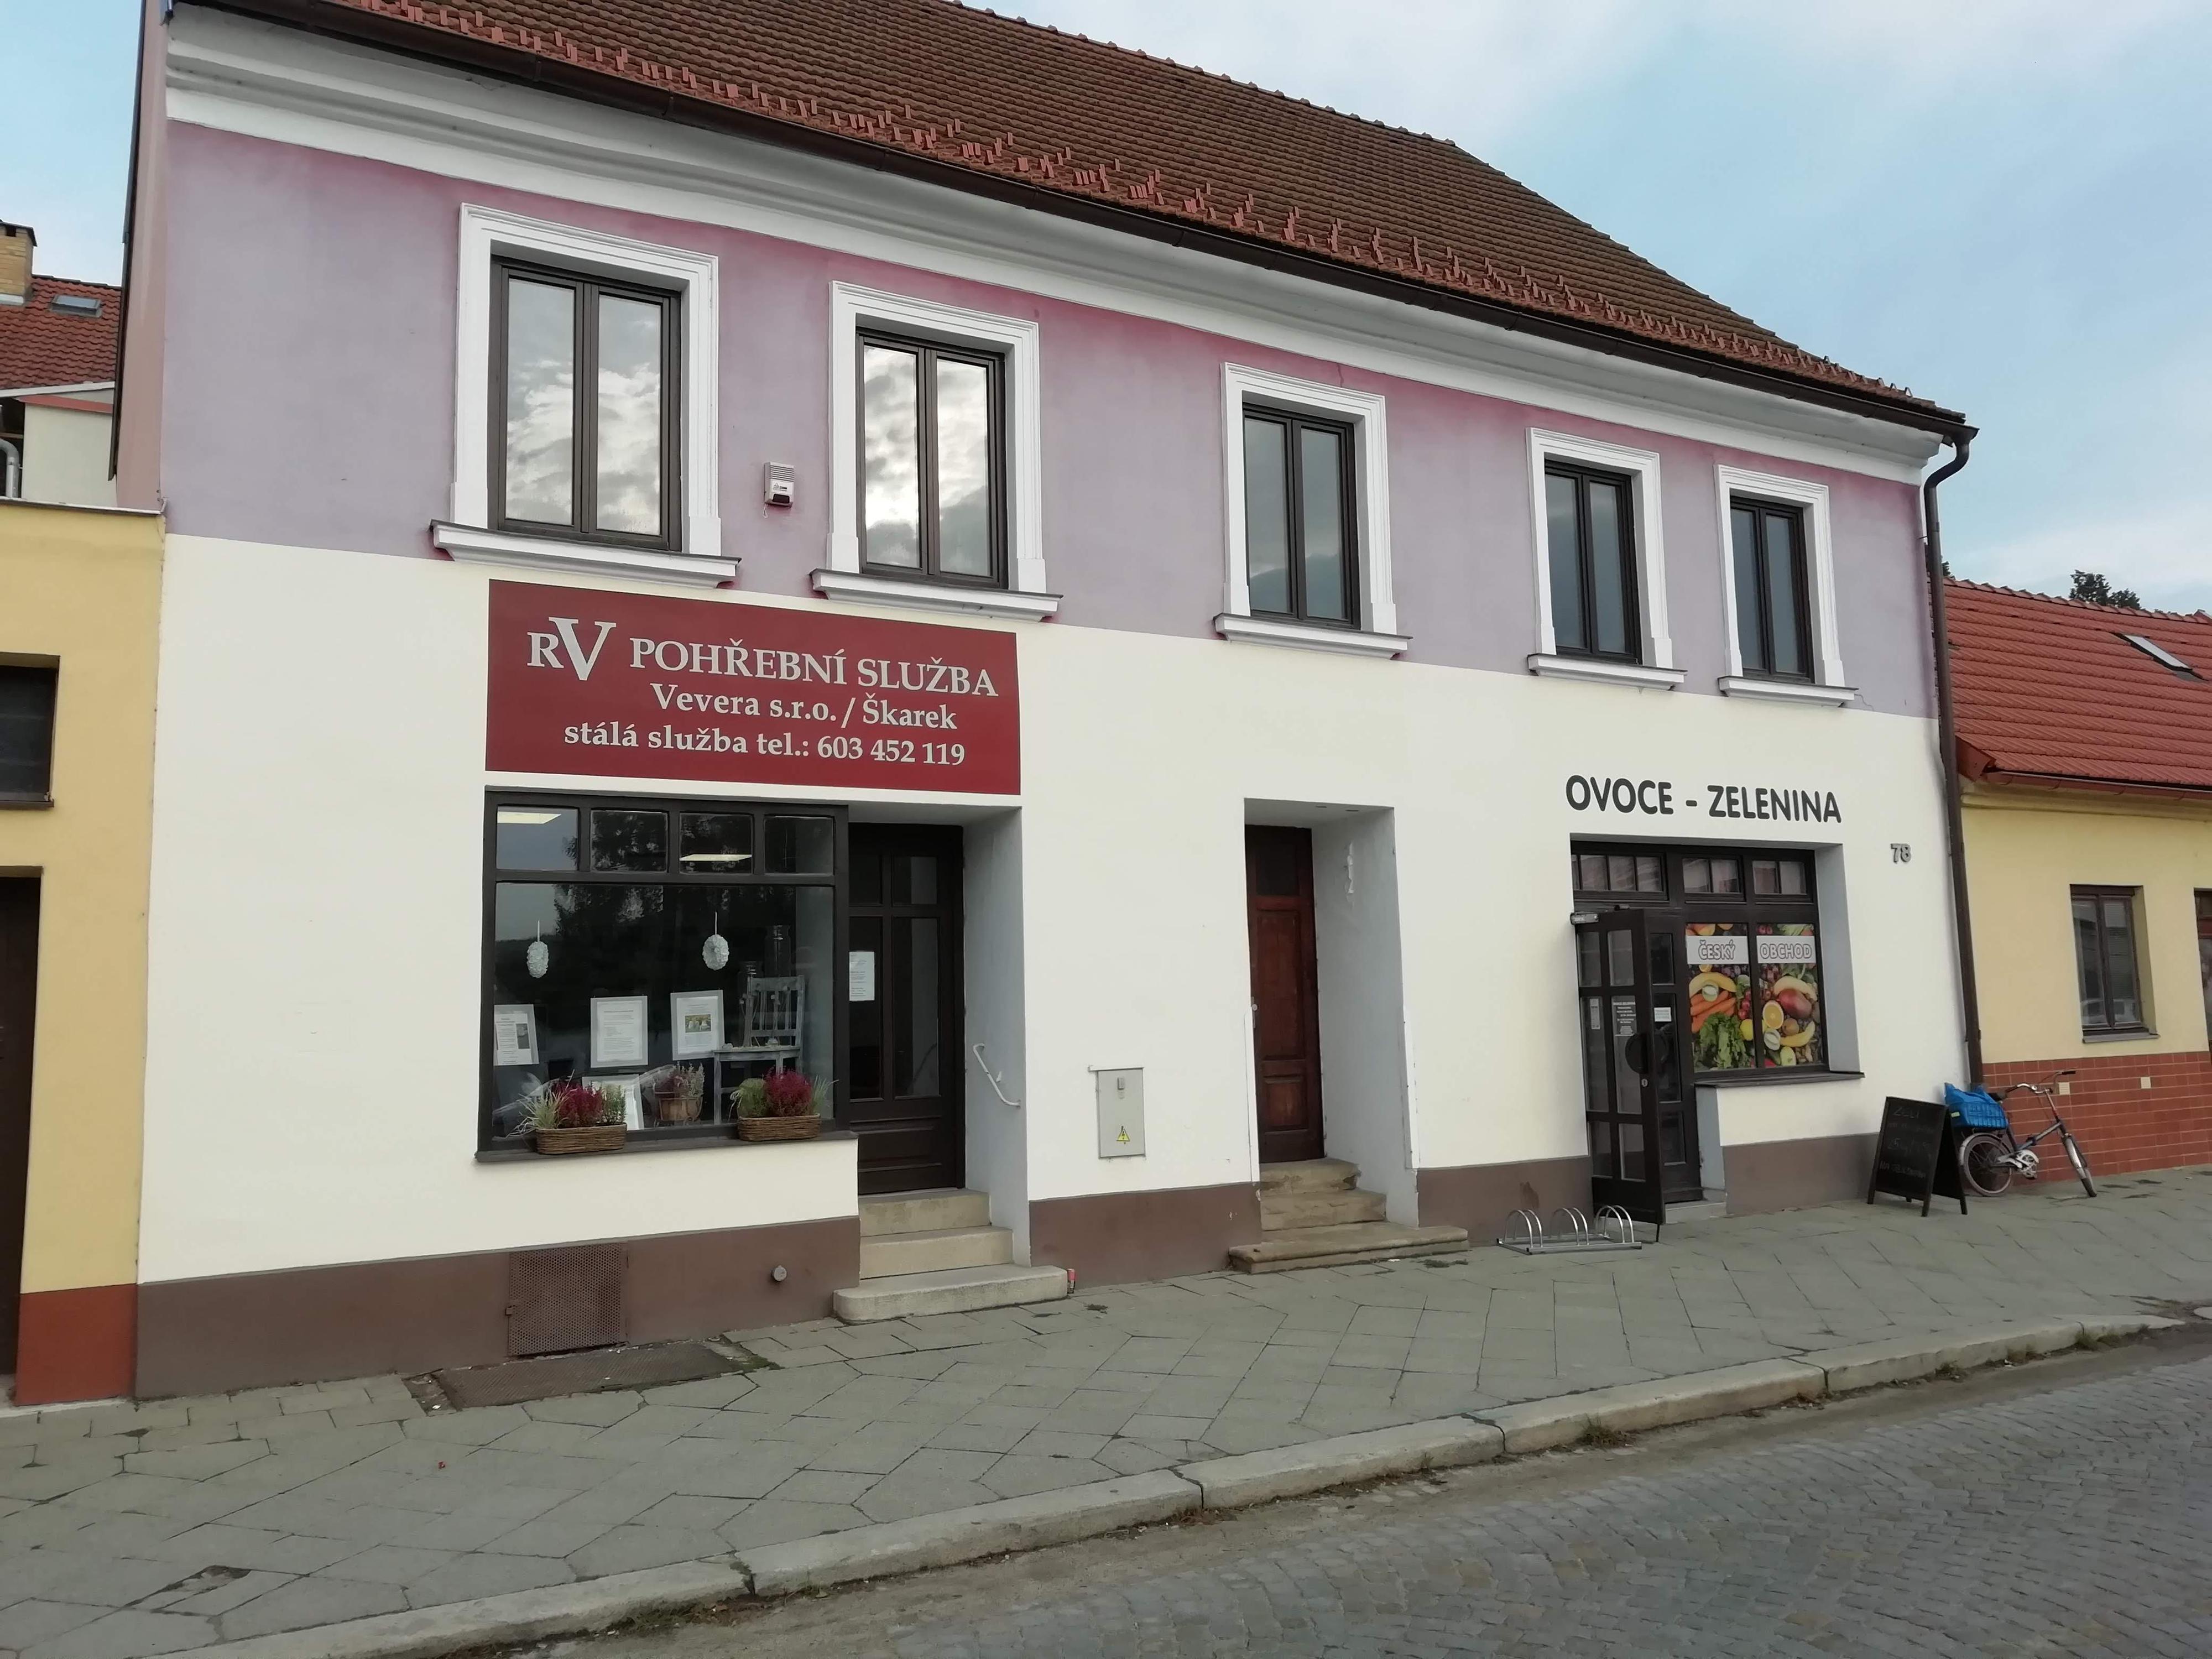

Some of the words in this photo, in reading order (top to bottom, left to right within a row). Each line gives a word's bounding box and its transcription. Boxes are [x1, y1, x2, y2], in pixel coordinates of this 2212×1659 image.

[629, 638, 847, 685] POHŘEBNÍ
[857, 656, 999, 697] SLUŽBA
[650, 683, 760, 716] Vevera
[770, 698, 837, 722] s.r.o.
[841, 697, 857, 728] /
[863, 692, 957, 729] Škarek
[564, 722, 639, 748] stálá
[648, 725, 748, 753] služba
[757, 732, 809, 757] tel.:
[817, 735, 863, 760] 603
[870, 739, 916, 763] 452
[922, 743, 966, 766] 119
[1566, 775, 1674, 815] OVOCE
[1707, 785, 1842, 823] ZELENINA
[1890, 843, 1912, 864] 78
[1698, 939, 1736, 960] ČESKÝ
[1760, 943, 1812, 959] OBCHOD
